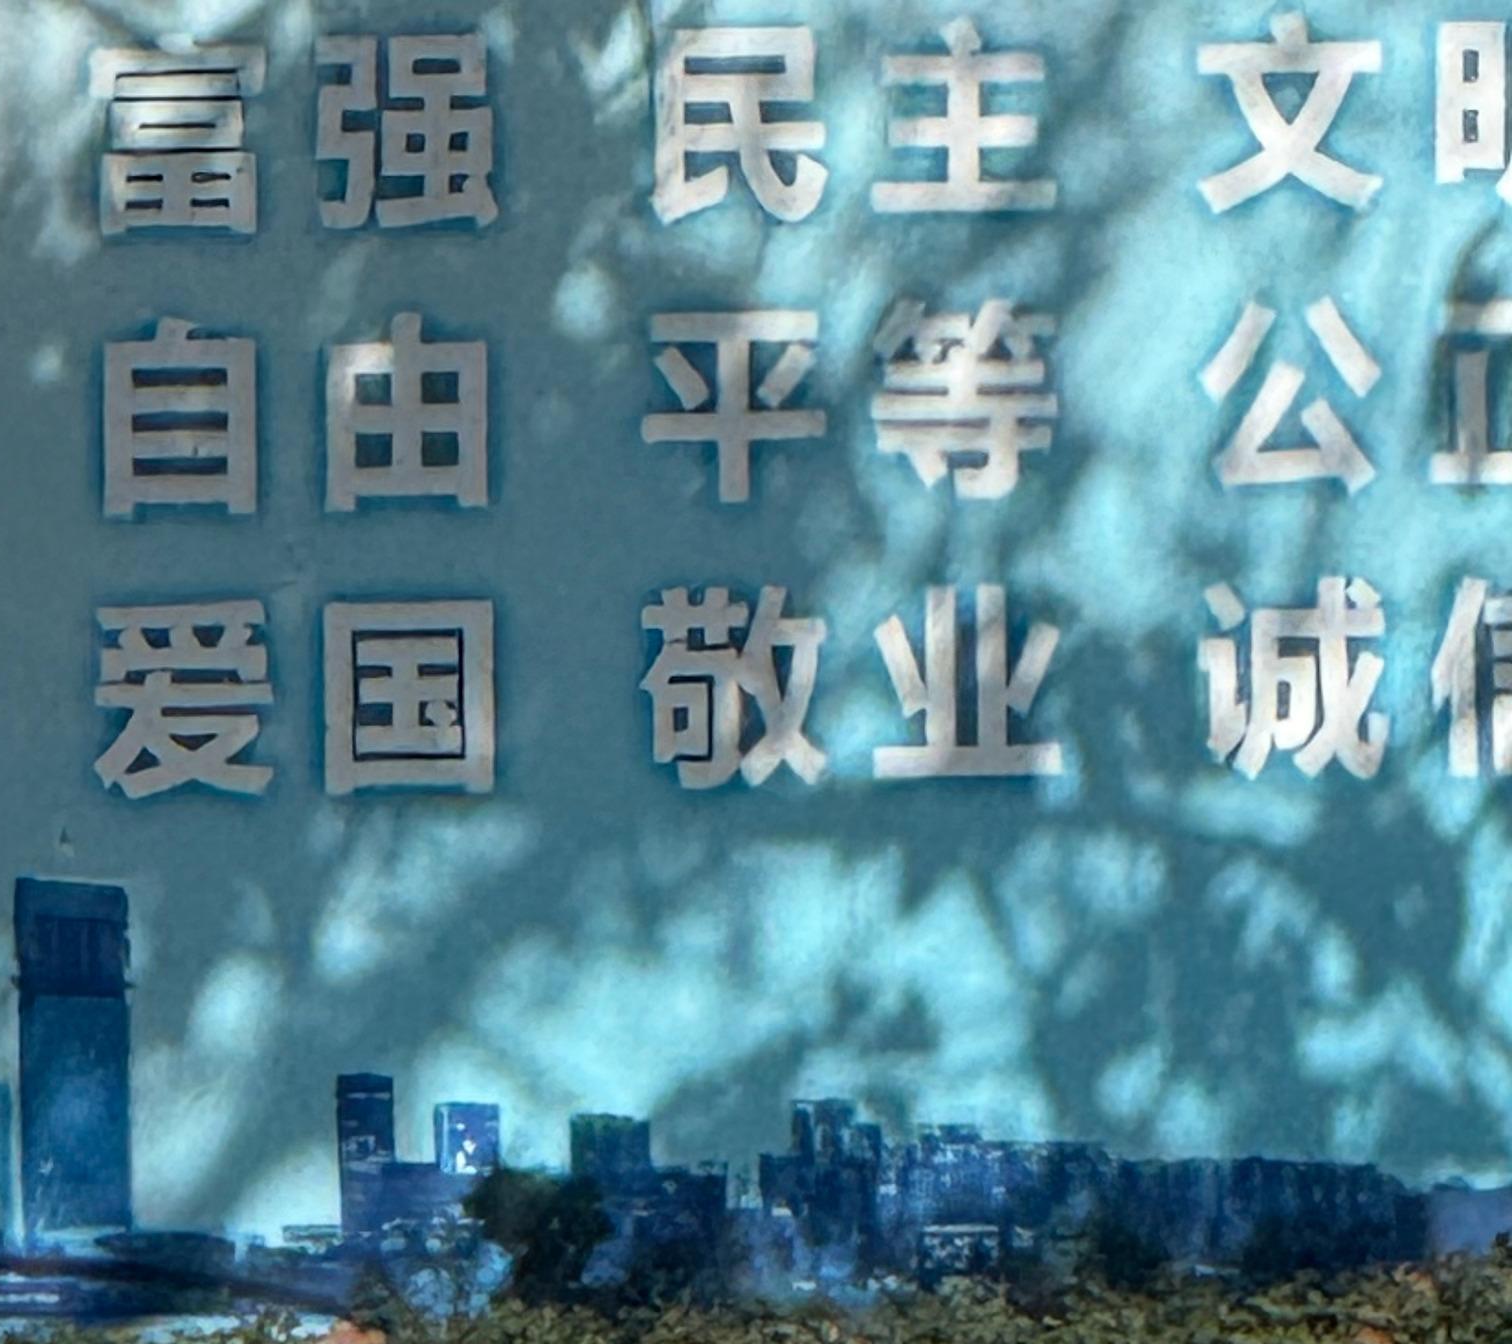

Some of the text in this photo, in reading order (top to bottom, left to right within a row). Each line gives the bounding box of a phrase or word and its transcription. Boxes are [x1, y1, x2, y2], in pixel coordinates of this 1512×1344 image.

[90, 34, 498, 236] 富强
[649, 15, 1057, 225] 民主
[103, 311, 488, 517] 自由
[641, 300, 1058, 503] 平等
[94, 598, 493, 797] 爱国
[640, 584, 1064, 786] 敬业
